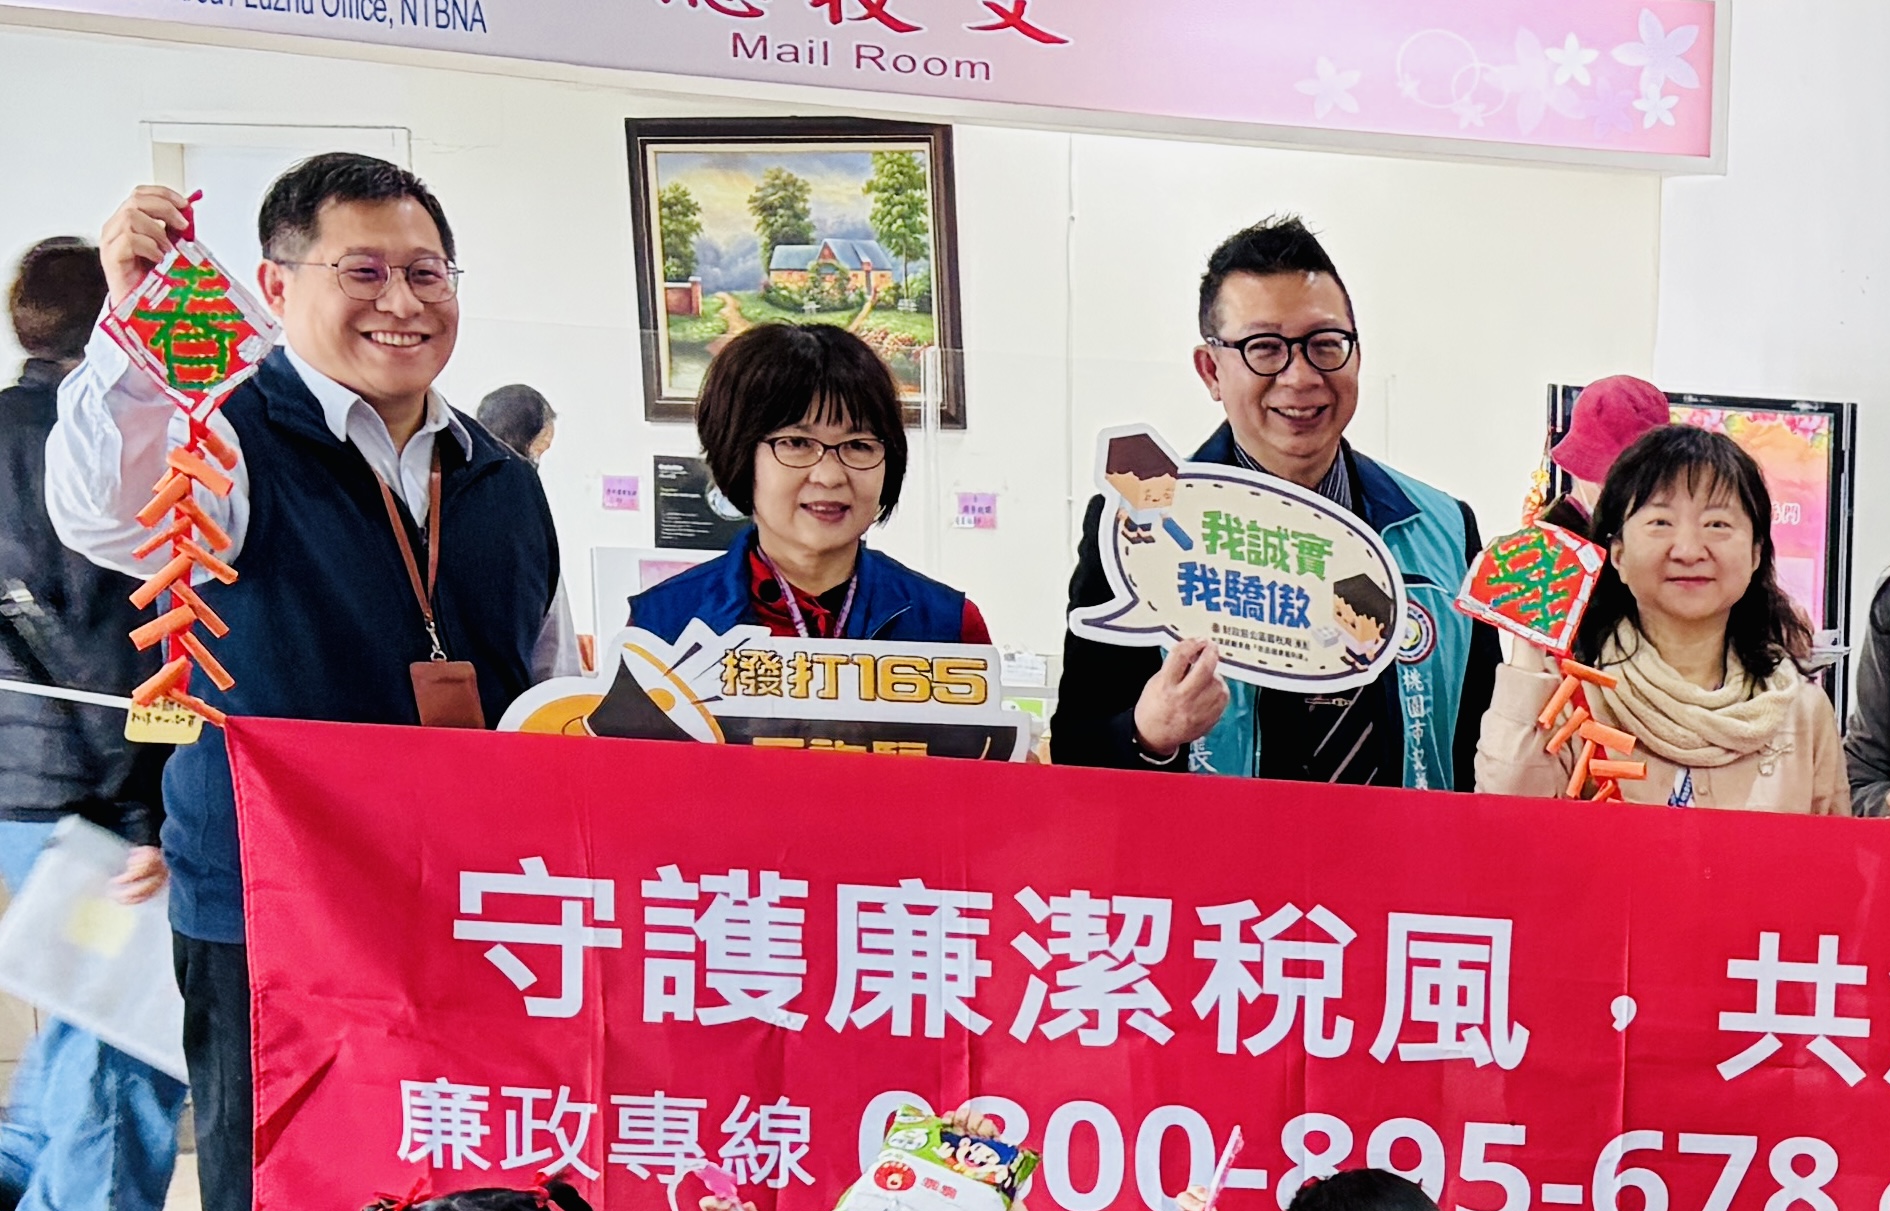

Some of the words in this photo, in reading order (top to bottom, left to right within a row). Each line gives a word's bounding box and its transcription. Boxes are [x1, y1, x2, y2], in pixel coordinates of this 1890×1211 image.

[400, 0, 487, 33] NTBNA
[731, 32, 829, 66] Mail
[855, 44, 990, 80] Room
[134, 262, 240, 392] 春
[1201, 510, 1334, 581] 我誠實
[1177, 561, 1311, 630] 我驕傲
[720, 647, 989, 705] 撥打165
[397, 1076, 817, 1188] 廉政專線
